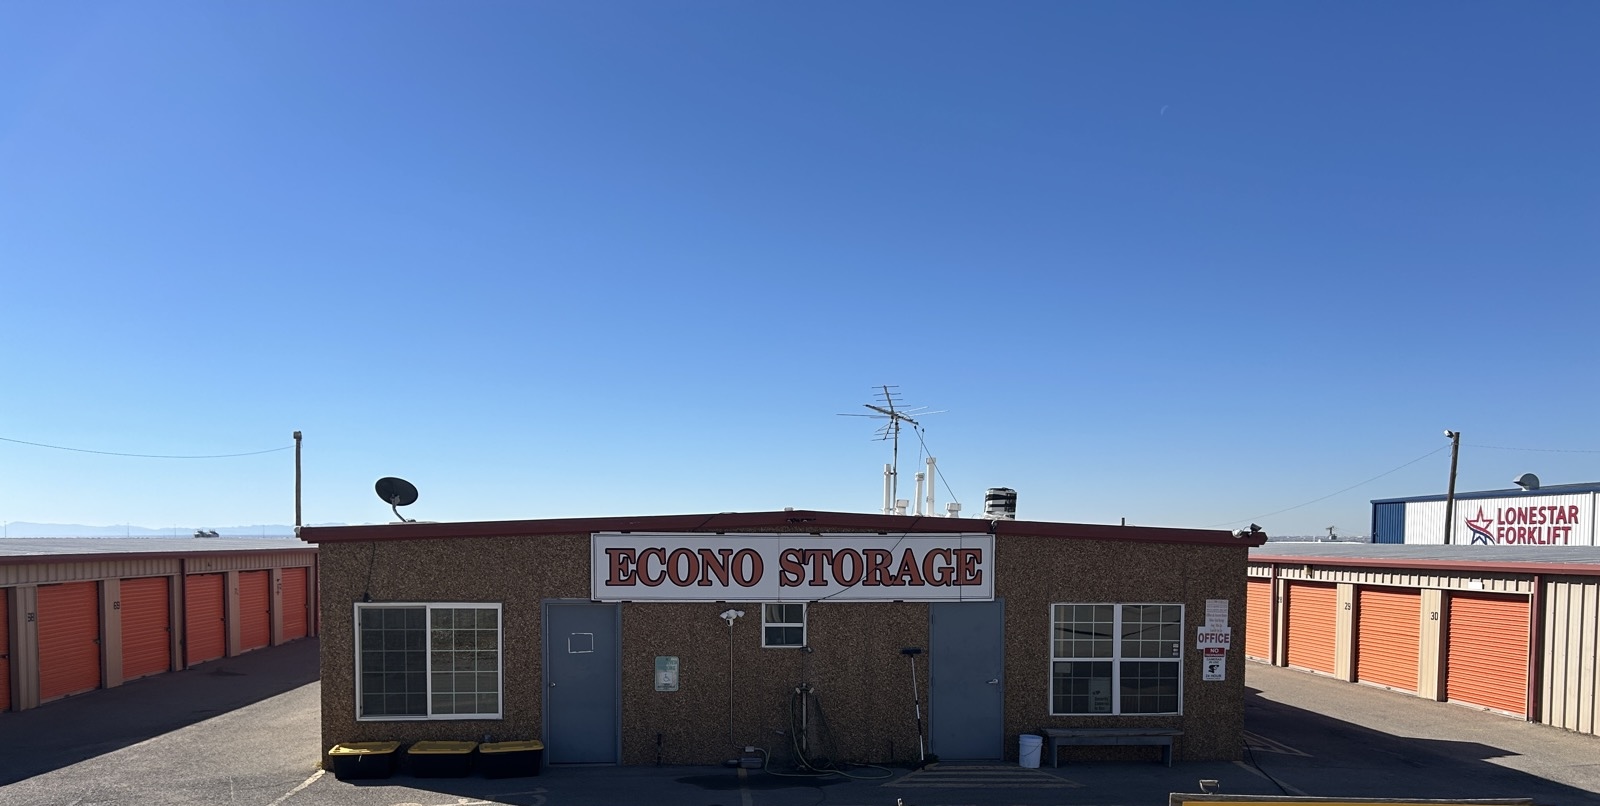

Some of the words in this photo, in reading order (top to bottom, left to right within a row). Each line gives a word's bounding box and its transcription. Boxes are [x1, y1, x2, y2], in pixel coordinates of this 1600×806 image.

[1497, 505, 1579, 525] LONESTAR
[1497, 526, 1572, 545] FORKLIFT
[605, 547, 764, 587] ECONO
[779, 547, 983, 587] STORAGE
[1344, 602, 1351, 611] 29
[1430, 611, 1439, 621] 30
[1198, 633, 1230, 644] OFFICE
